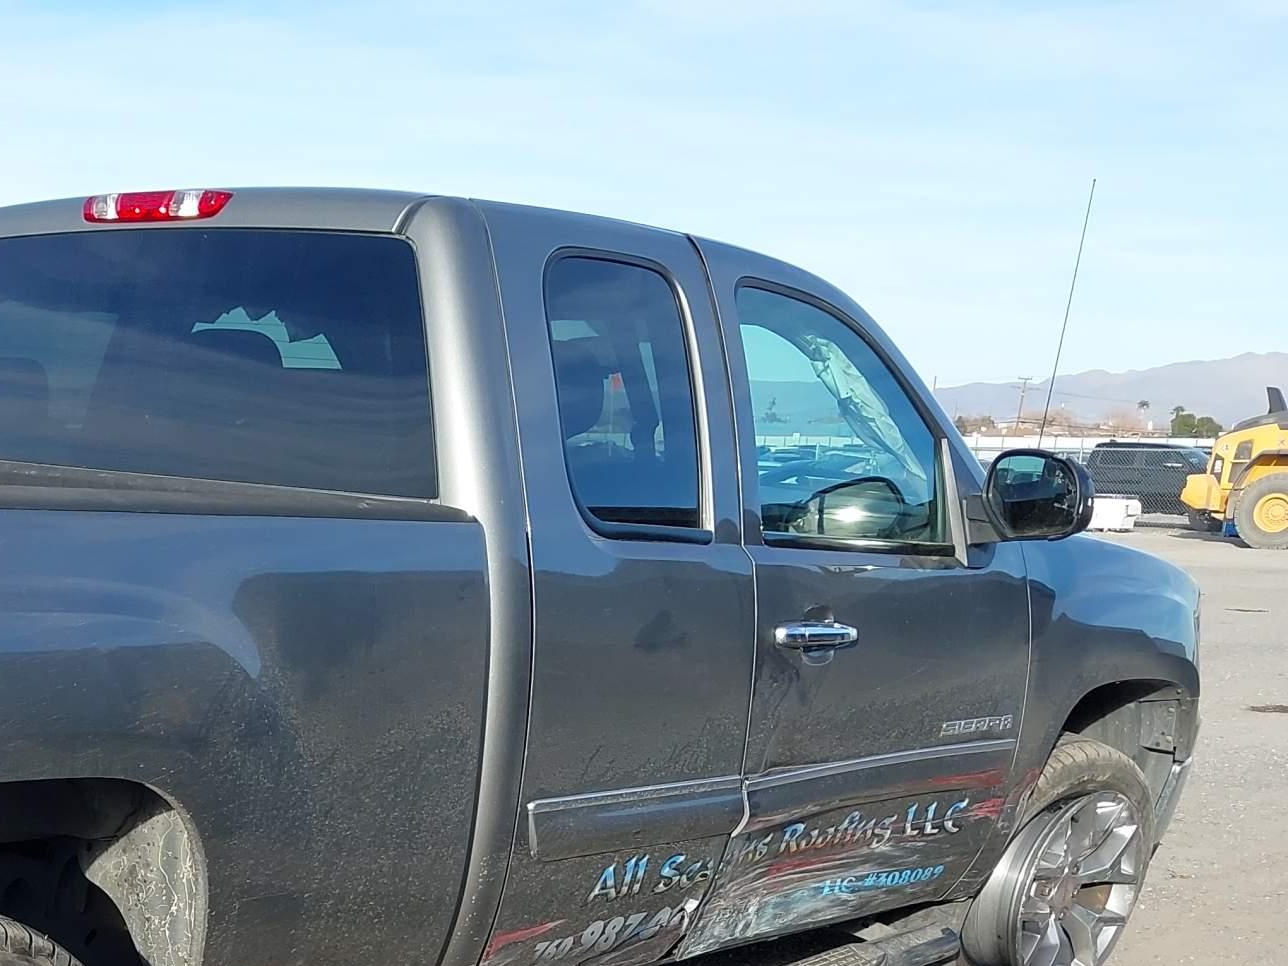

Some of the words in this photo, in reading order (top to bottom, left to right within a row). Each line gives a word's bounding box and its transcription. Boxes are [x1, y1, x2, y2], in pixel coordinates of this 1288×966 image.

[939, 714, 1014, 737] SIERRA
[583, 853, 650, 904] All
[778, 810, 898, 853] Roofing
[903, 798, 970, 836] LLC
[863, 864, 946, 888] #308089
